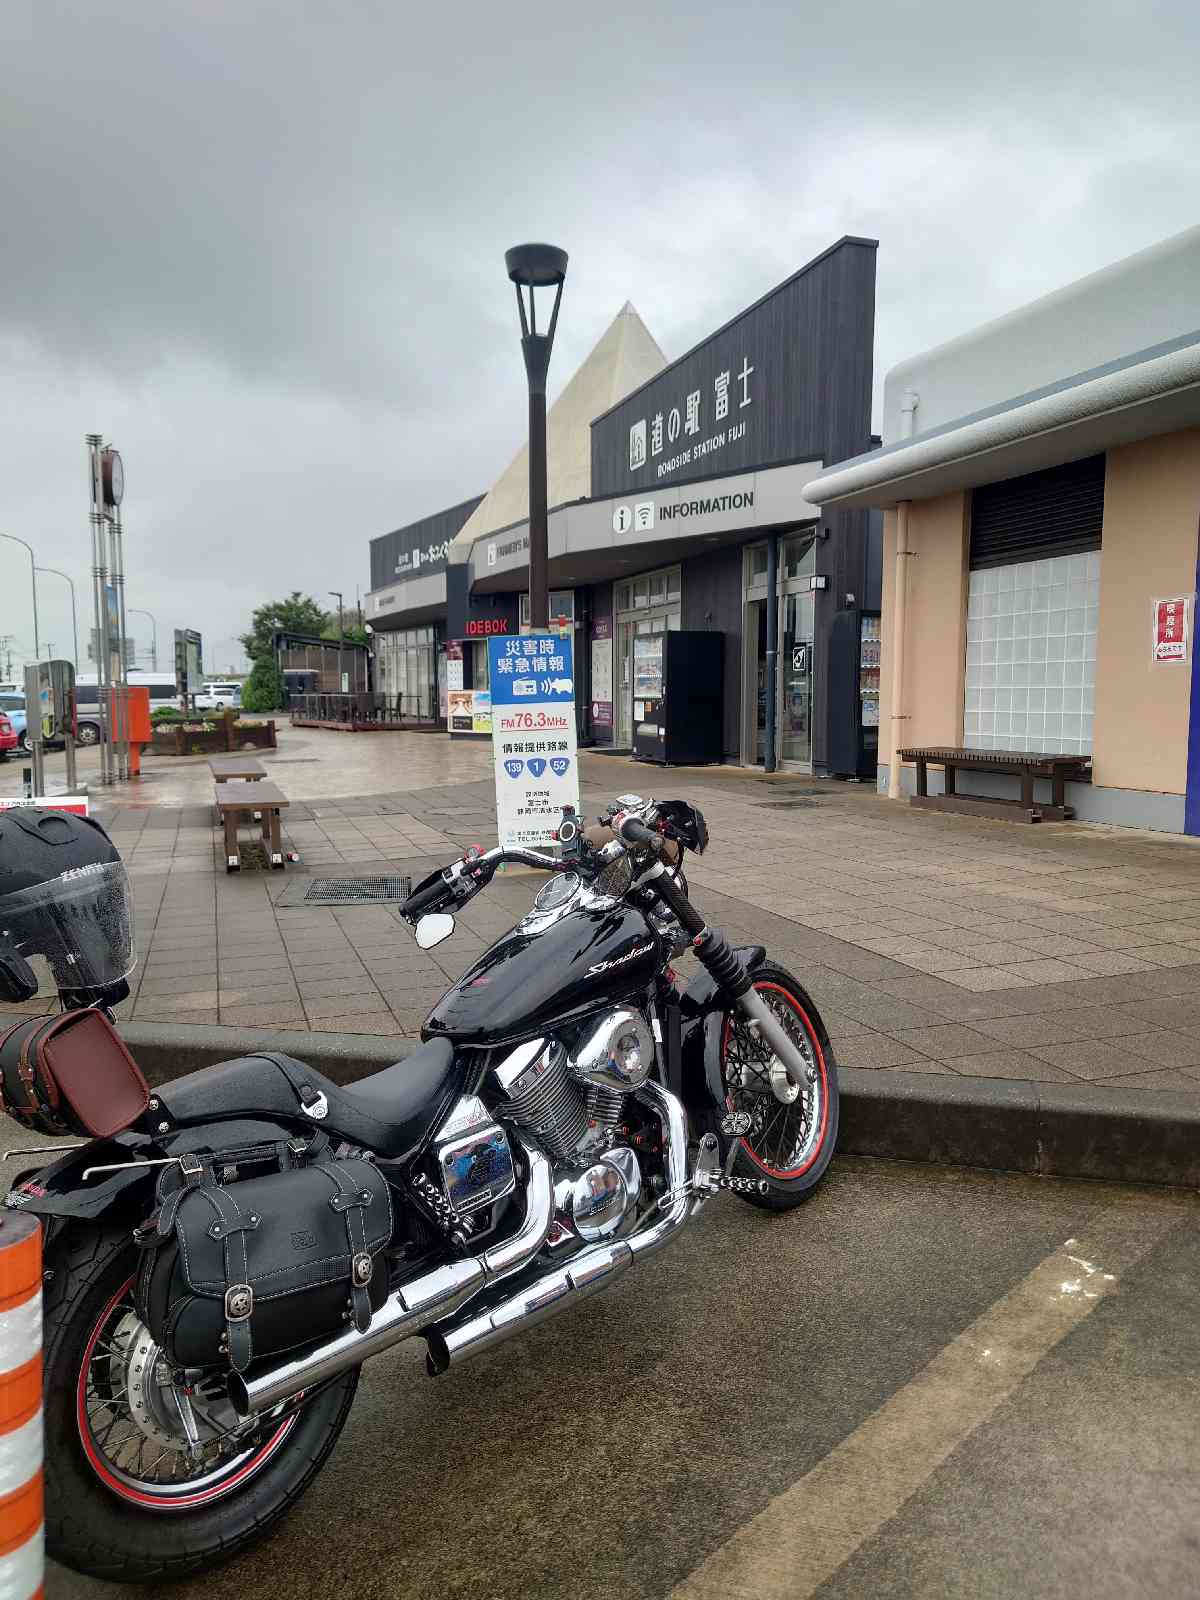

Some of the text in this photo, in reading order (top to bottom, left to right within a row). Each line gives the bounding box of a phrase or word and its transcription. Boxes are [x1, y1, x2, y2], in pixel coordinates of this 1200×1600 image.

[650, 357, 755, 457] 道の駅 富士
[693, 433, 726, 461] STATION
[728, 421, 747, 442] FUJI
[659, 491, 755, 520] INFORMATION
[505, 639, 555, 656] 災害時
[497, 656, 565, 674] 緊急情報
[502, 740, 568, 754] 情報提供路線
[506, 760, 566, 773] 139 1 52
[583, 941, 655, 979] Shadow
